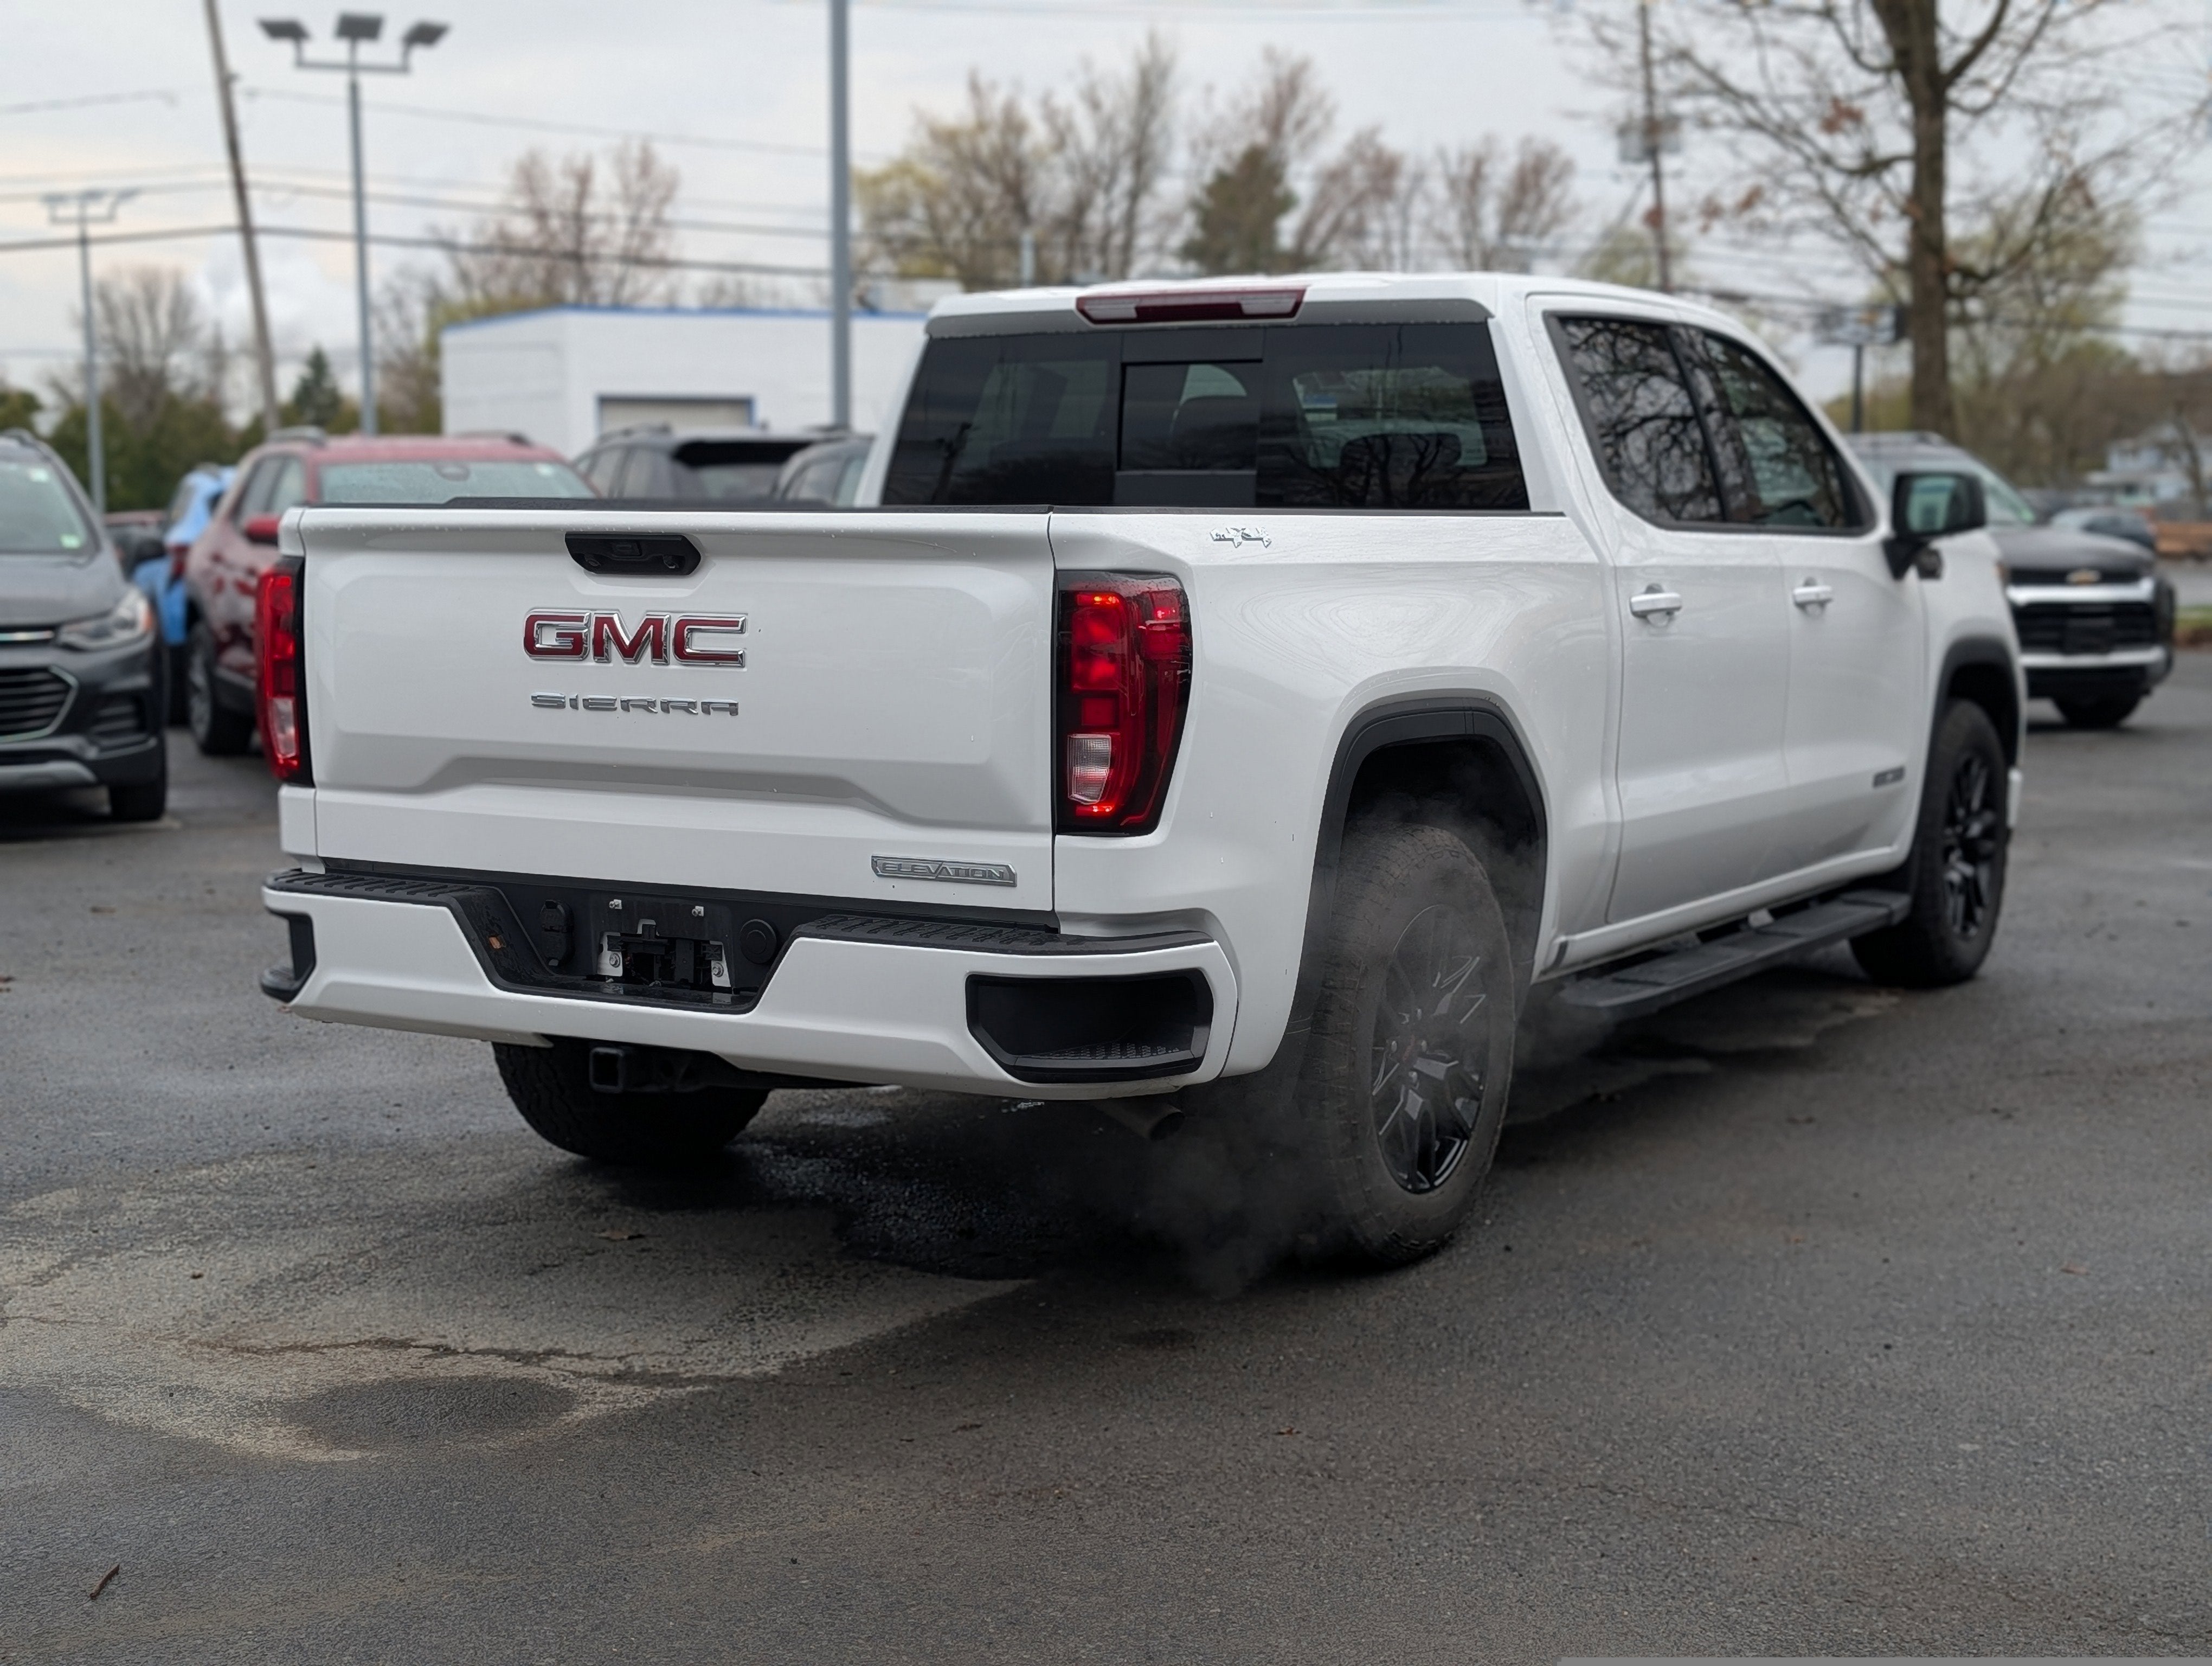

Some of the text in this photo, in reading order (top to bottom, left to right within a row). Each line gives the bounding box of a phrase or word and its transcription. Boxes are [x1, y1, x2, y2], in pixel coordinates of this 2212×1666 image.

[524, 608, 746, 668] GMC
[531, 691, 739, 716] SIERRA
[882, 861, 1004, 878] ELEVATION
